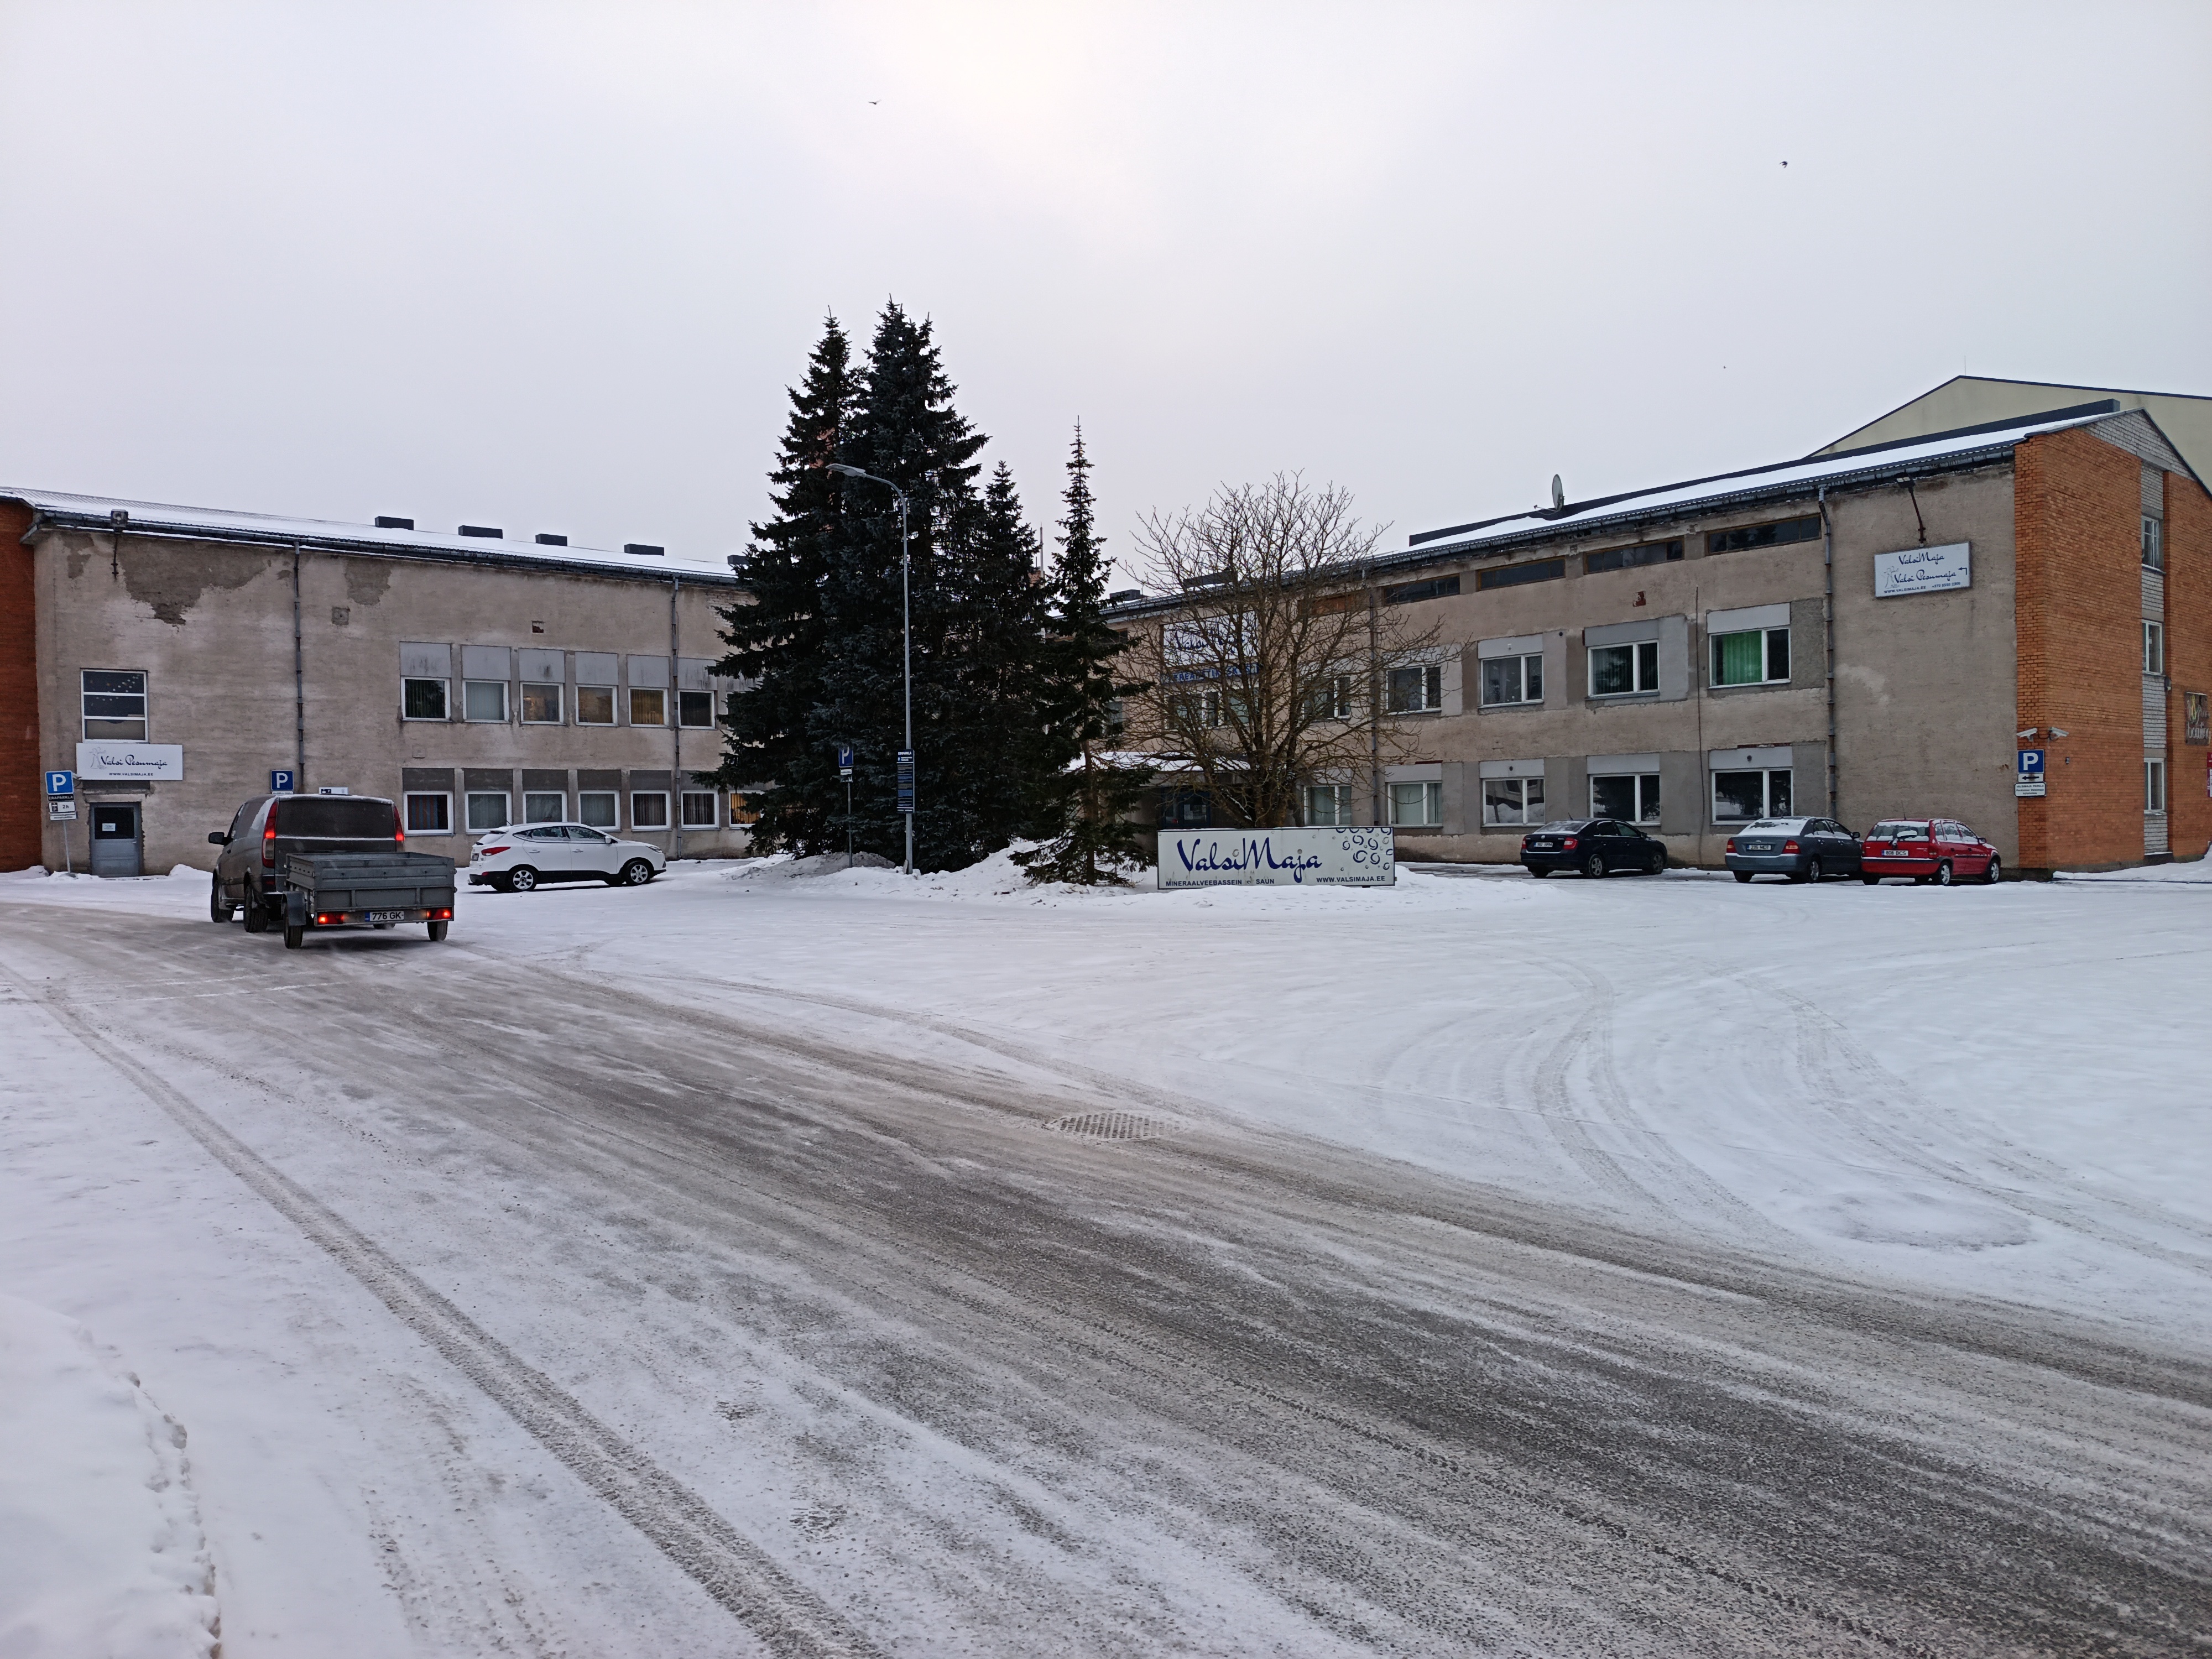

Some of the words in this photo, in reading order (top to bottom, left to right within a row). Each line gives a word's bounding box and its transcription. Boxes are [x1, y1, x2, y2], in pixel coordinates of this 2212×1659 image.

[1894, 573, 1914, 583] Valsi
[1916, 570, 1957, 581] Pesumaja
[101, 755, 123, 765] Valsi
[125, 754, 168, 769] Pesumaja
[2023, 753, 2038, 770] P
[52, 774, 66, 791] P
[276, 773, 288, 788] P
[1177, 837, 1322, 883] ValsiMaja
